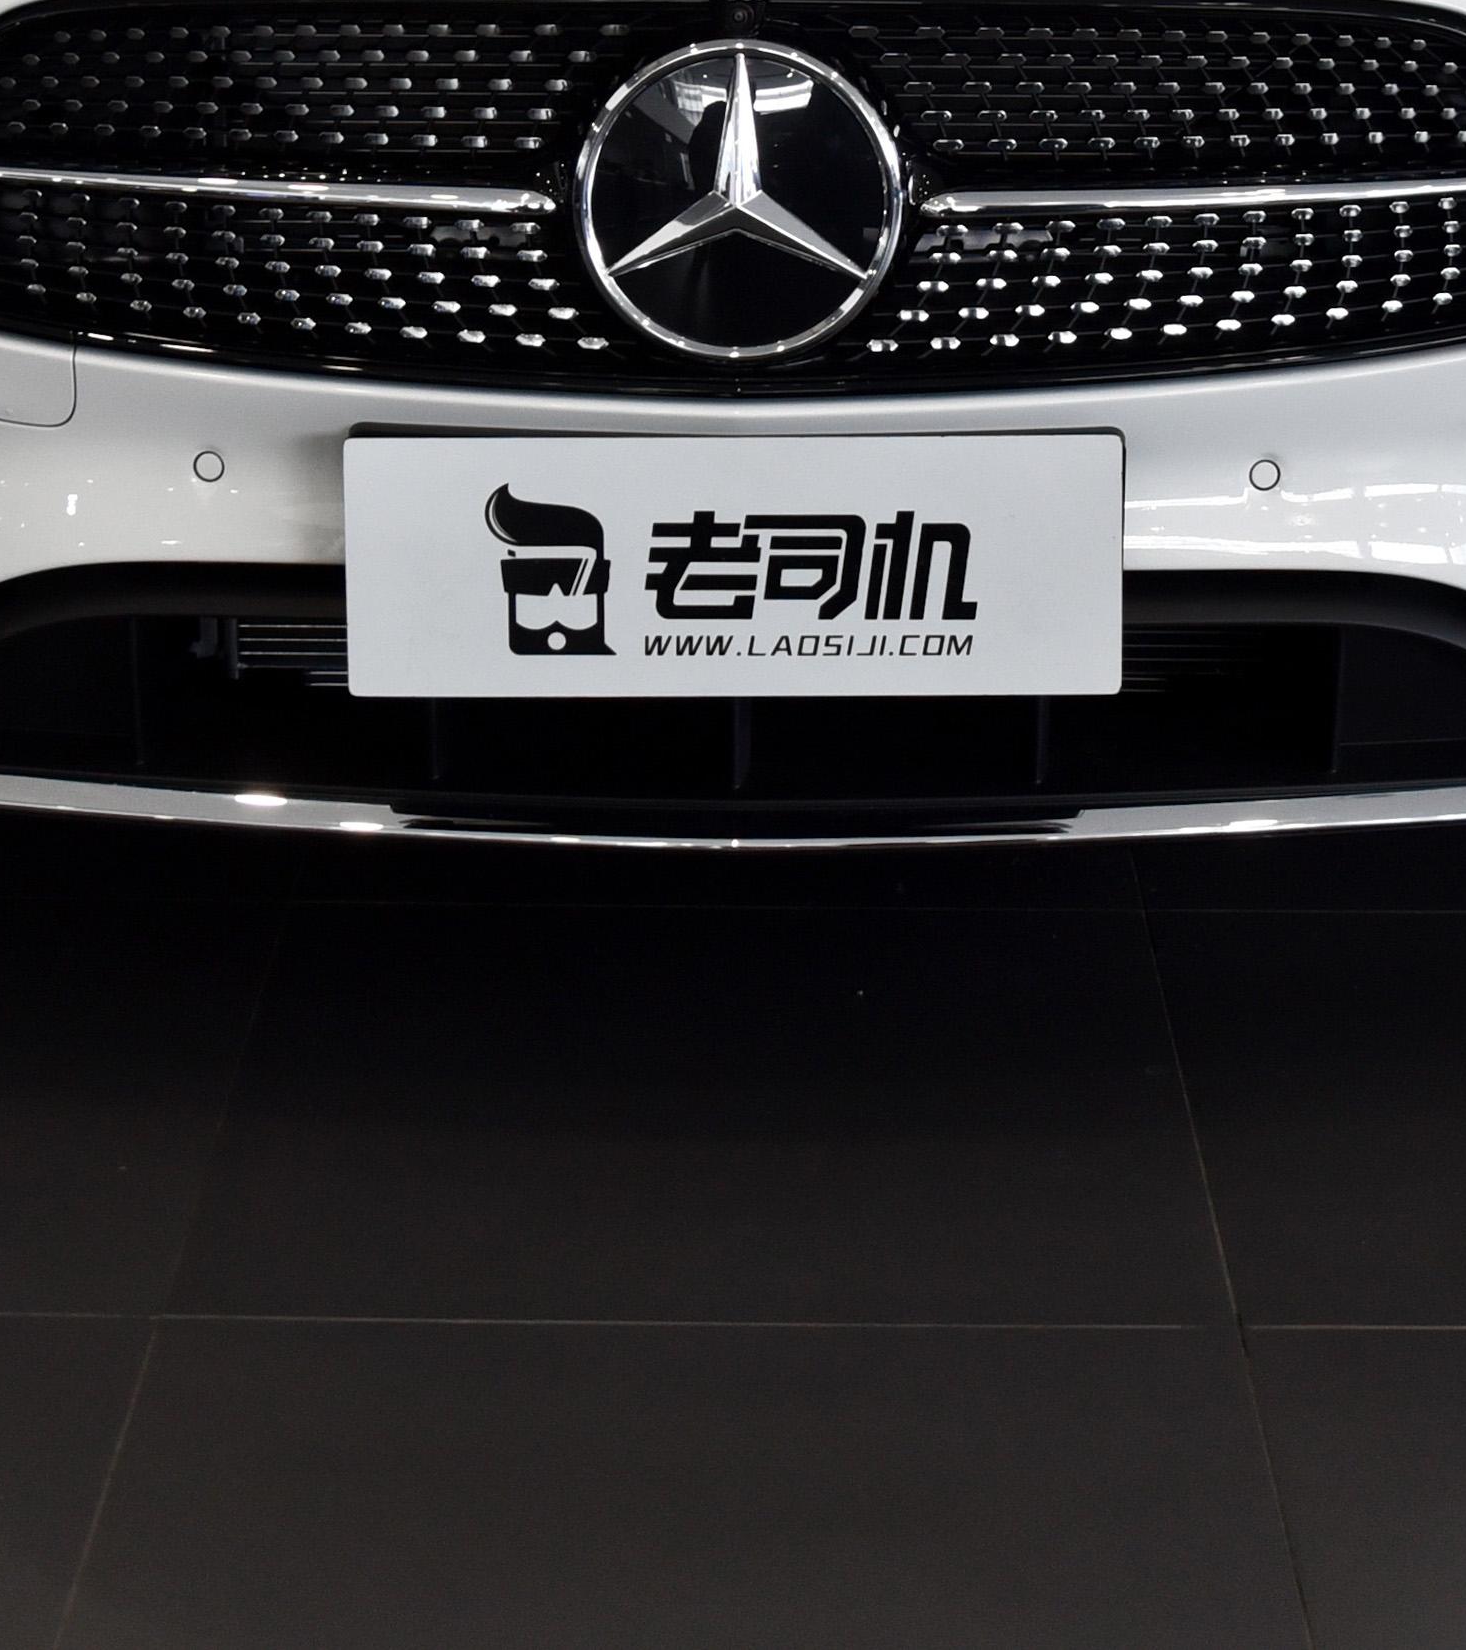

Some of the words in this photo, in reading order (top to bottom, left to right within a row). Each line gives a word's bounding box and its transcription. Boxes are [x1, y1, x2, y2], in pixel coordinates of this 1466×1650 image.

[644, 510, 978, 620] 老司机
[644, 634, 974, 658] WWW.LAOSIJI.COM
